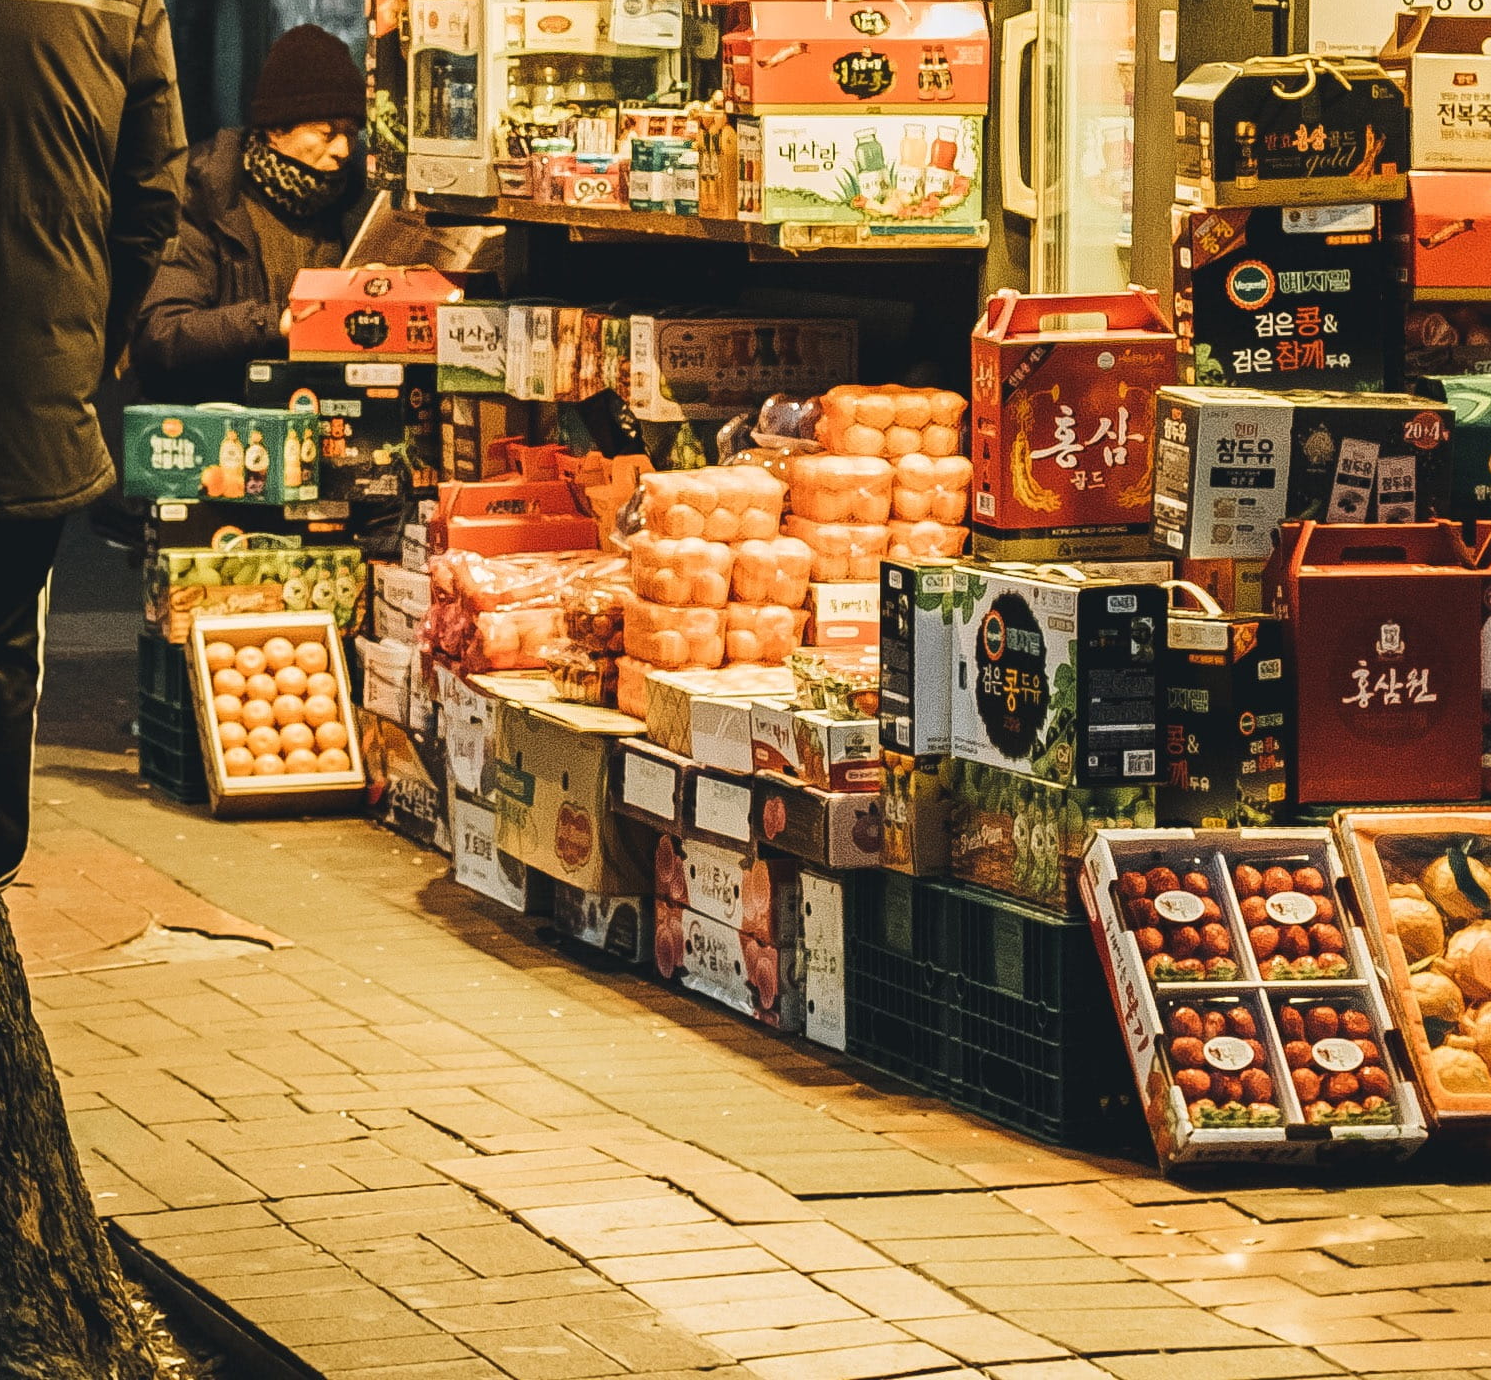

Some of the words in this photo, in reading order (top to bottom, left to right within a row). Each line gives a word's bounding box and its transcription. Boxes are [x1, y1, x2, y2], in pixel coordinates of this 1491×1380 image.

[778, 139, 839, 171] 내사랑
[1305, 144, 1358, 178] gold
[1278, 269, 1352, 294] 베지밀
[448, 324, 504, 351] 내사랑
[1255, 306, 1322, 338] 검은콩
[1323, 313, 1339, 334] &
[1232, 348, 1274, 375] 검은
[1275, 338, 1352, 372] 참깨두유
[1029, 404, 1146, 469] 홍삼
[1216, 437, 1275, 465] 참두유
[1069, 470, 1106, 491] 골드
[982, 663, 1043, 713] 검은콩두유
[1342, 659, 1437, 709] 홍삼원
[1168, 687, 1210, 714] 지밀
[1186, 733, 1200, 754] &
